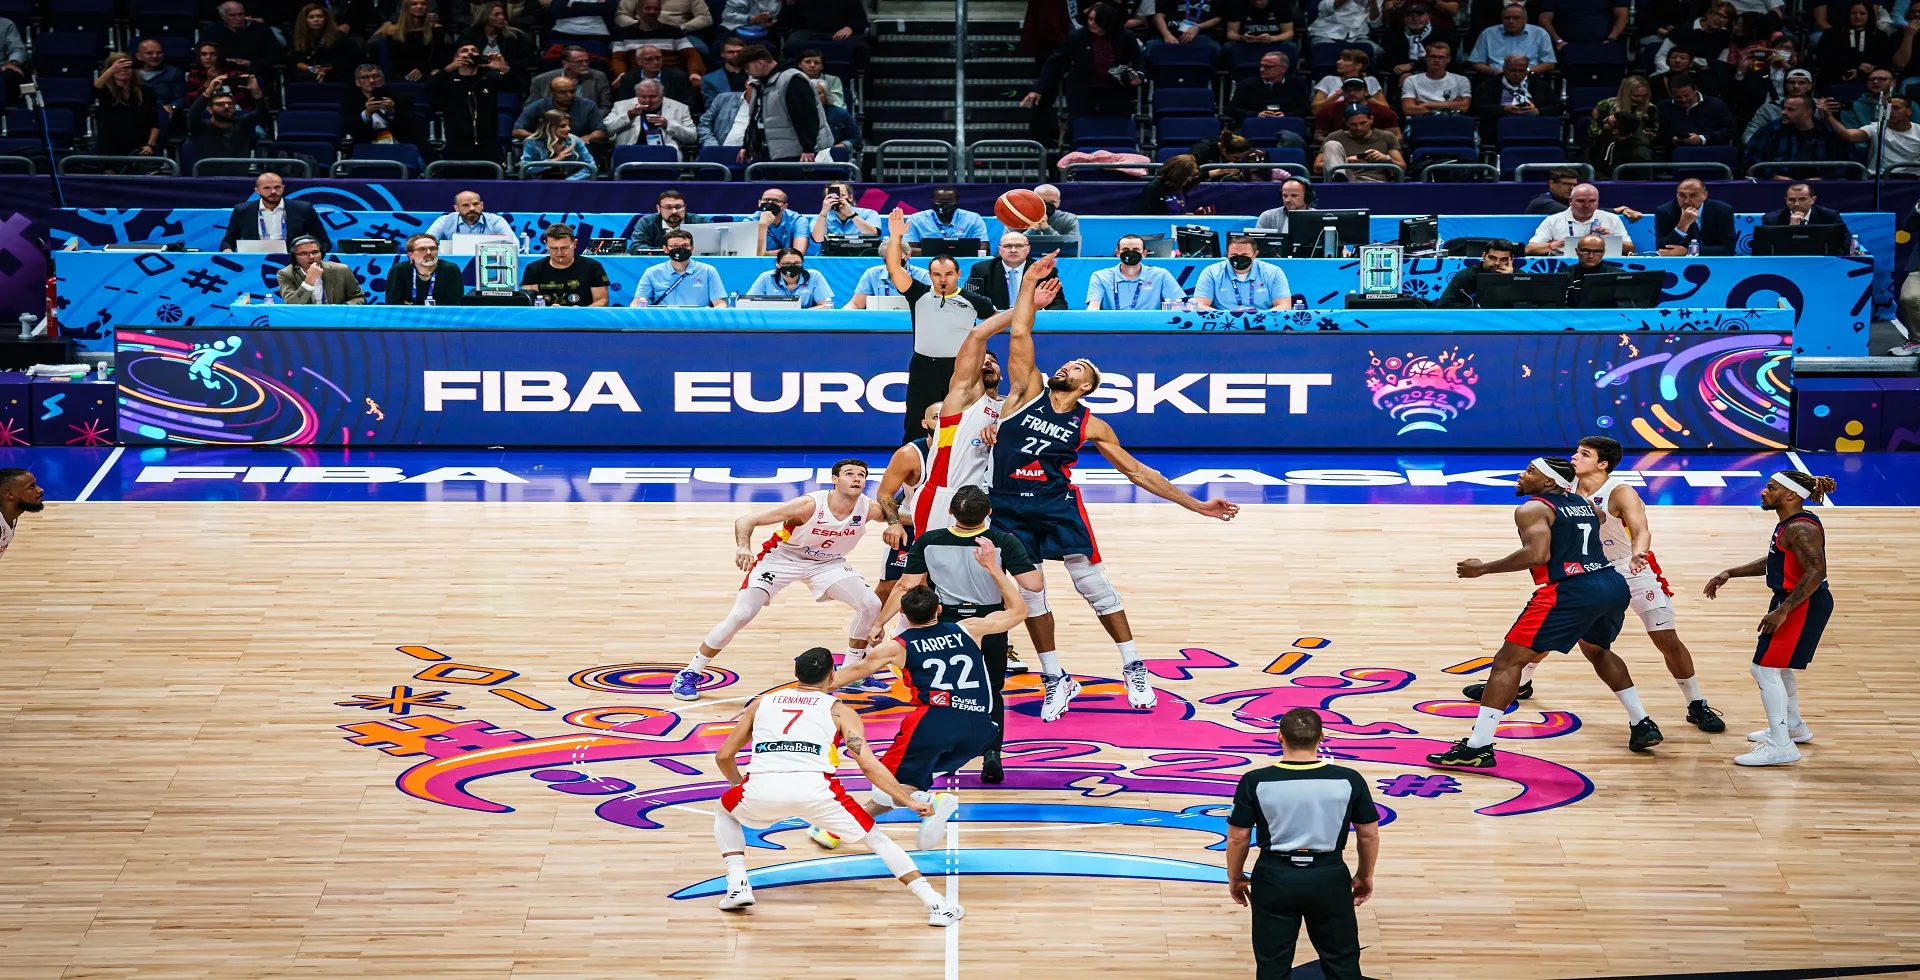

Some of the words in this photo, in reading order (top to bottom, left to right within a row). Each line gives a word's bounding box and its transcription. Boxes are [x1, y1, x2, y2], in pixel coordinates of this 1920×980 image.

[424, 371, 642, 412] FIBA
[674, 371, 1332, 414] EUROSKET
[1401, 391, 1448, 405] 2022
[1020, 414, 1073, 443] FRANCE
[1020, 436, 1051, 456] 27
[135, 466, 531, 484] FIBA
[1015, 468, 1045, 477] MAIF
[820, 539, 835, 549] 6
[1577, 523, 1593, 556] 7
[910, 633, 965, 654] TARPEY
[922, 654, 980, 691] 22
[772, 694, 820, 707] FERNÁNDEZ
[782, 709, 804, 735] 7
[767, 742, 818, 755] CaixaBank
